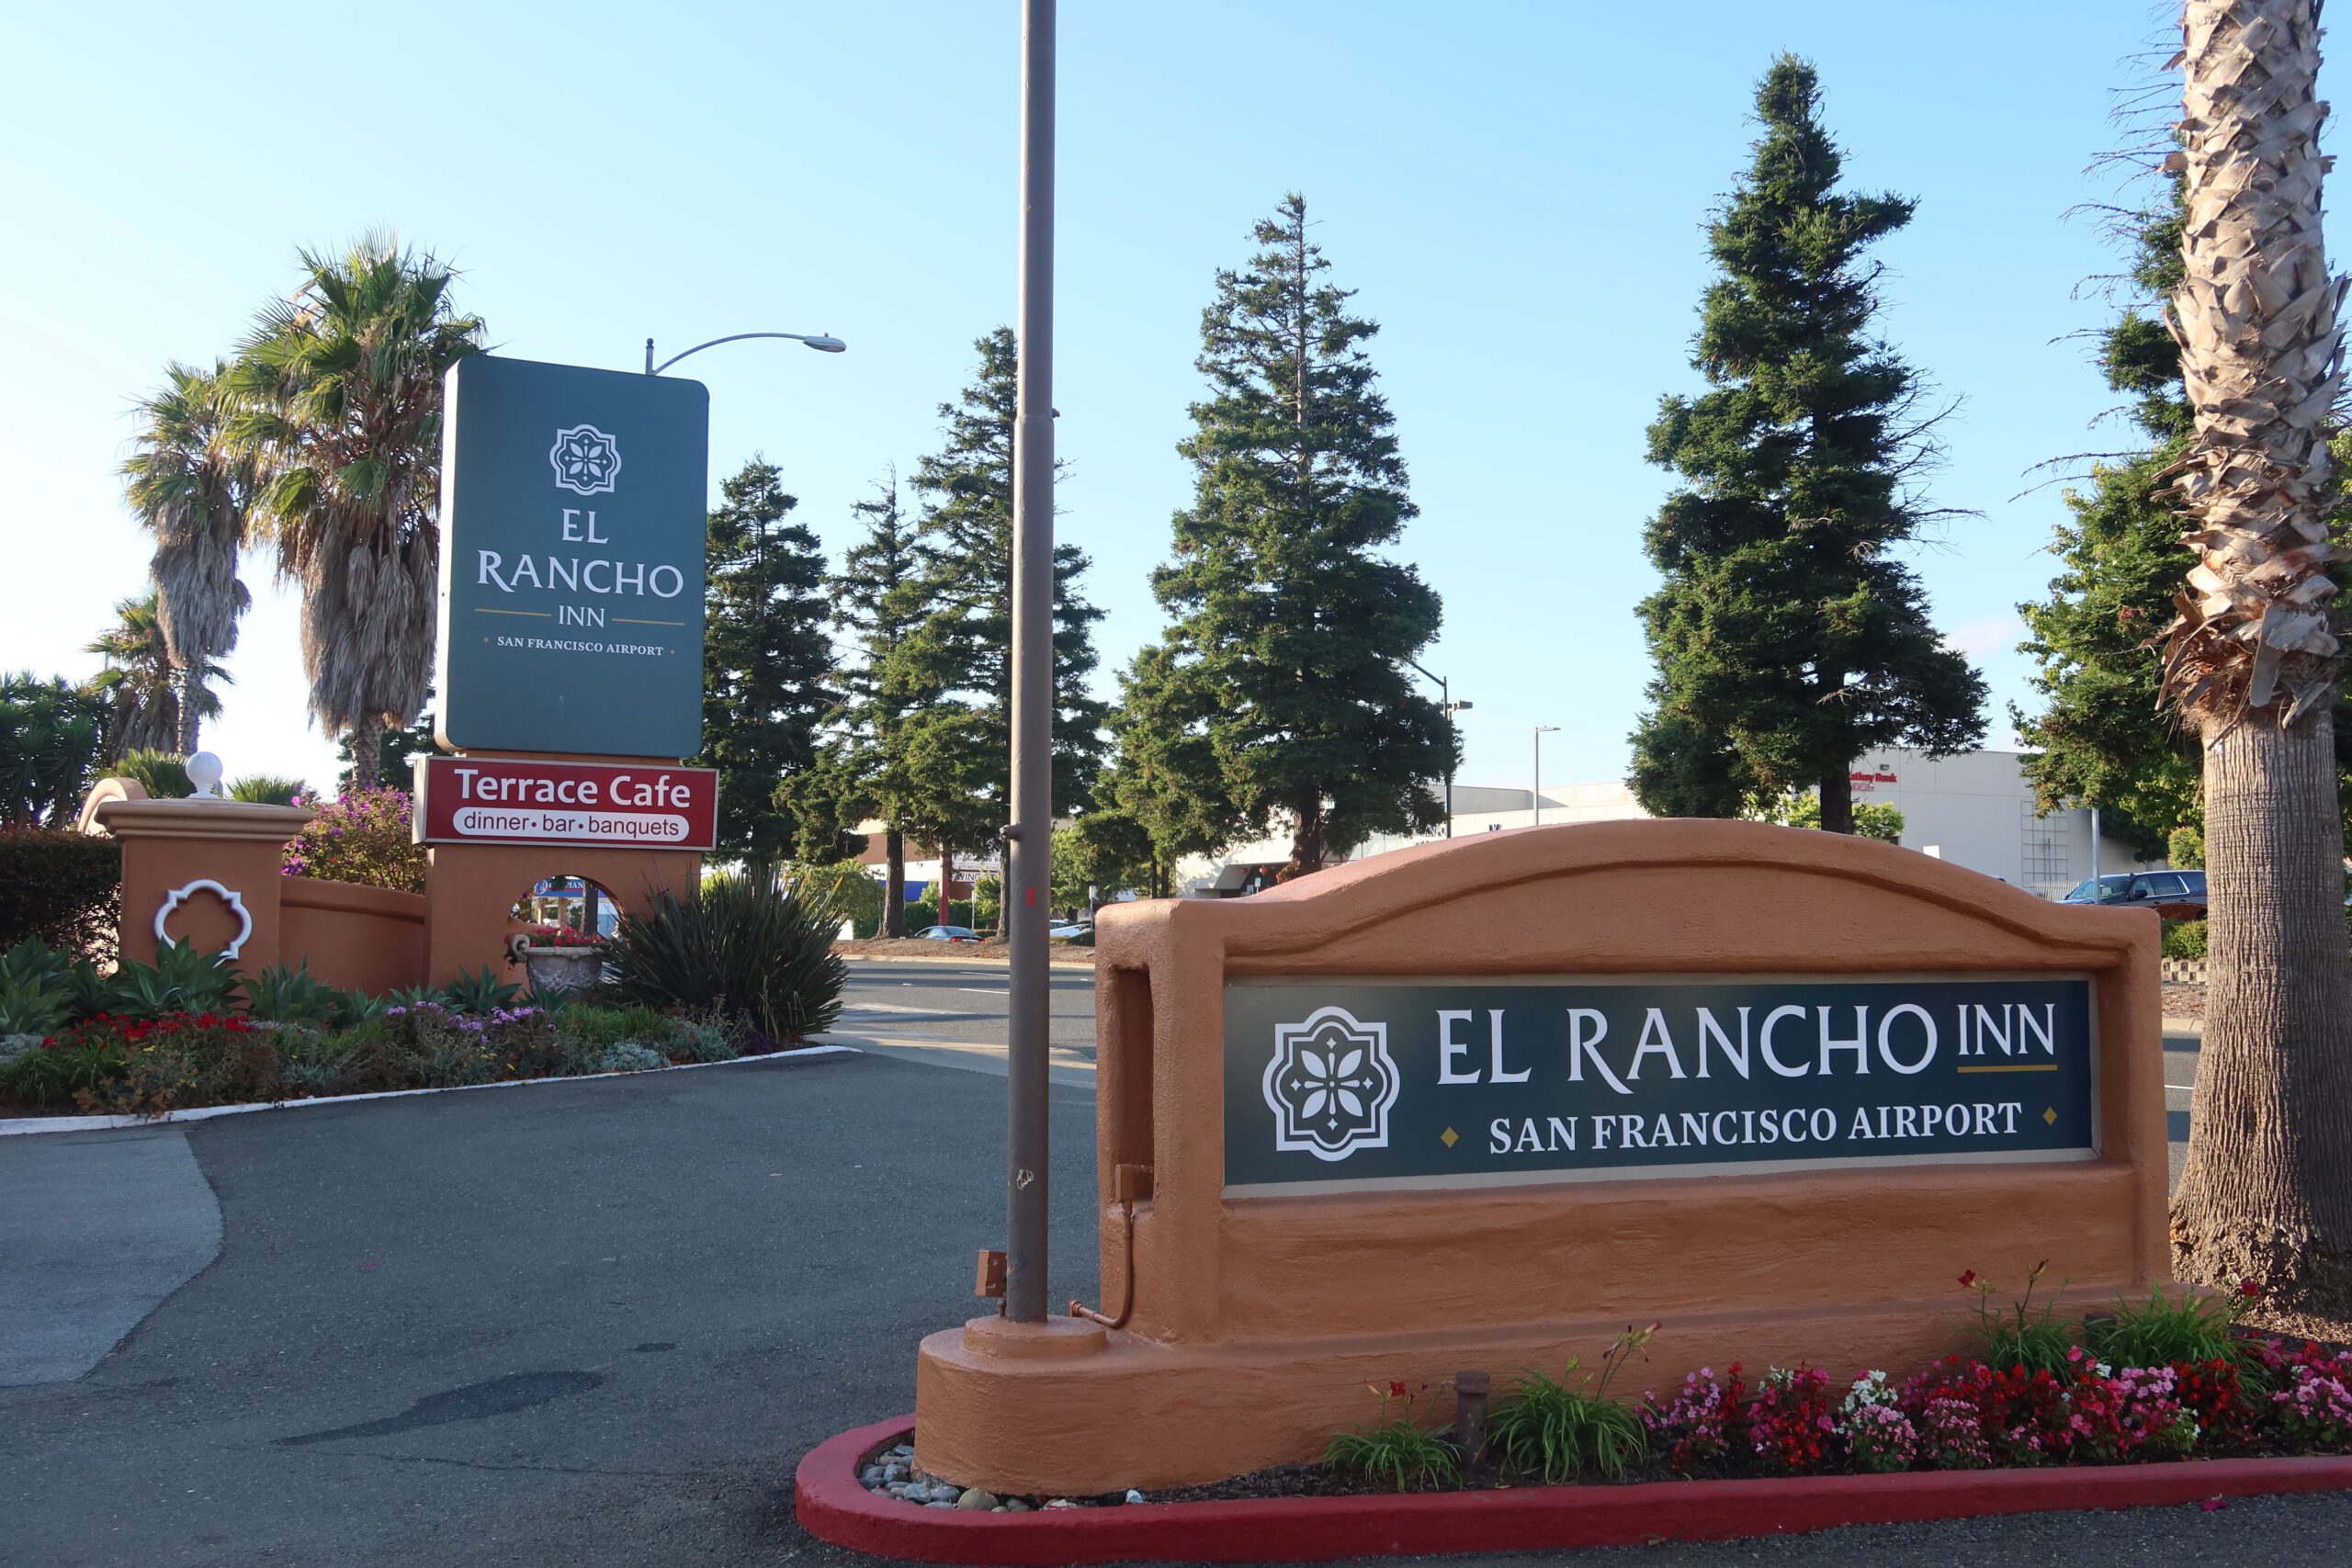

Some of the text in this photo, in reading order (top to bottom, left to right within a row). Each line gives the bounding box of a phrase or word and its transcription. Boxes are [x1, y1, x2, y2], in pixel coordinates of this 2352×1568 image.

[561, 508, 609, 544] EL
[477, 549, 684, 598] RANCHO
[558, 604, 605, 628] INN
[497, 636, 664, 656] SAN FRANCISCO AIRPORT
[454, 768, 691, 808] Terrace Cafe
[463, 811, 679, 839] dinner bar banquets
[1435, 1003, 2055, 1095] EL RANCHO INN
[1489, 1102, 2022, 1155] SAN FRANCISCO AIRPORT
